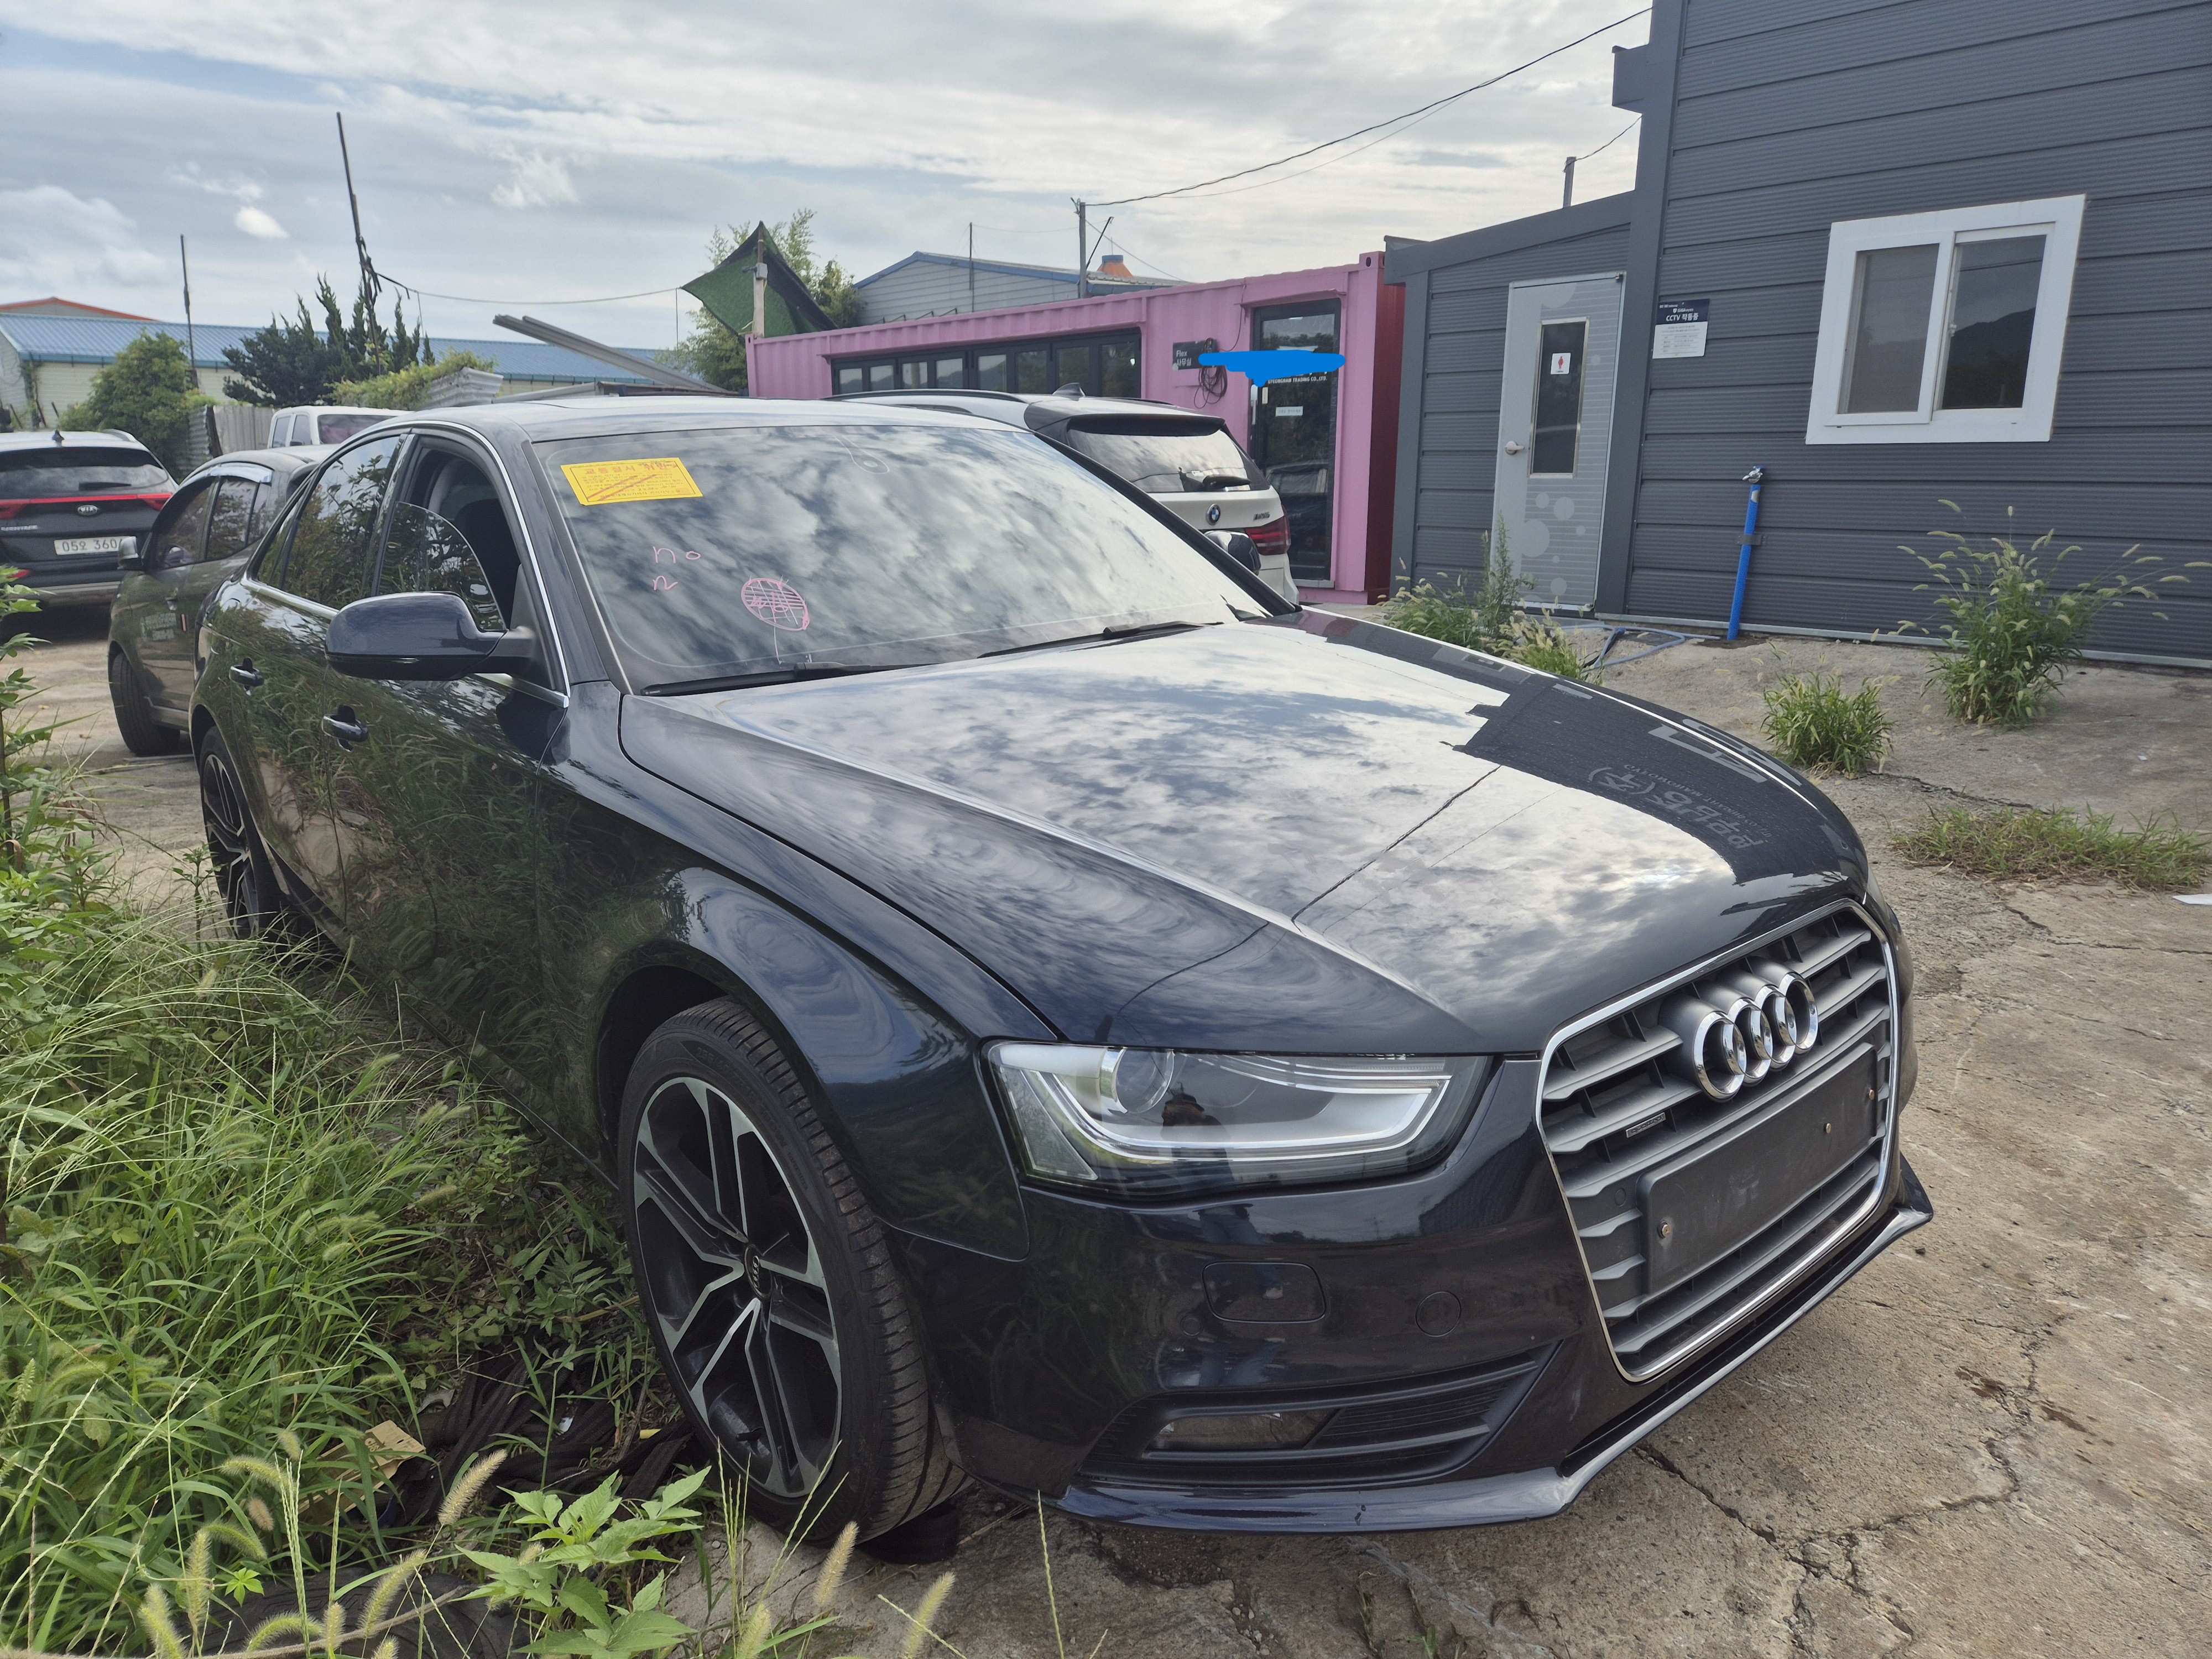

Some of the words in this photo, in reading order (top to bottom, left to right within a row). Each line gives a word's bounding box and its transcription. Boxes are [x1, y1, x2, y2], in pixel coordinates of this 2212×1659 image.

[1176, 357, 1192, 367] 사무실
[93, 538, 122, 550] 360
[1631, 1116, 1662, 1134] quattro
